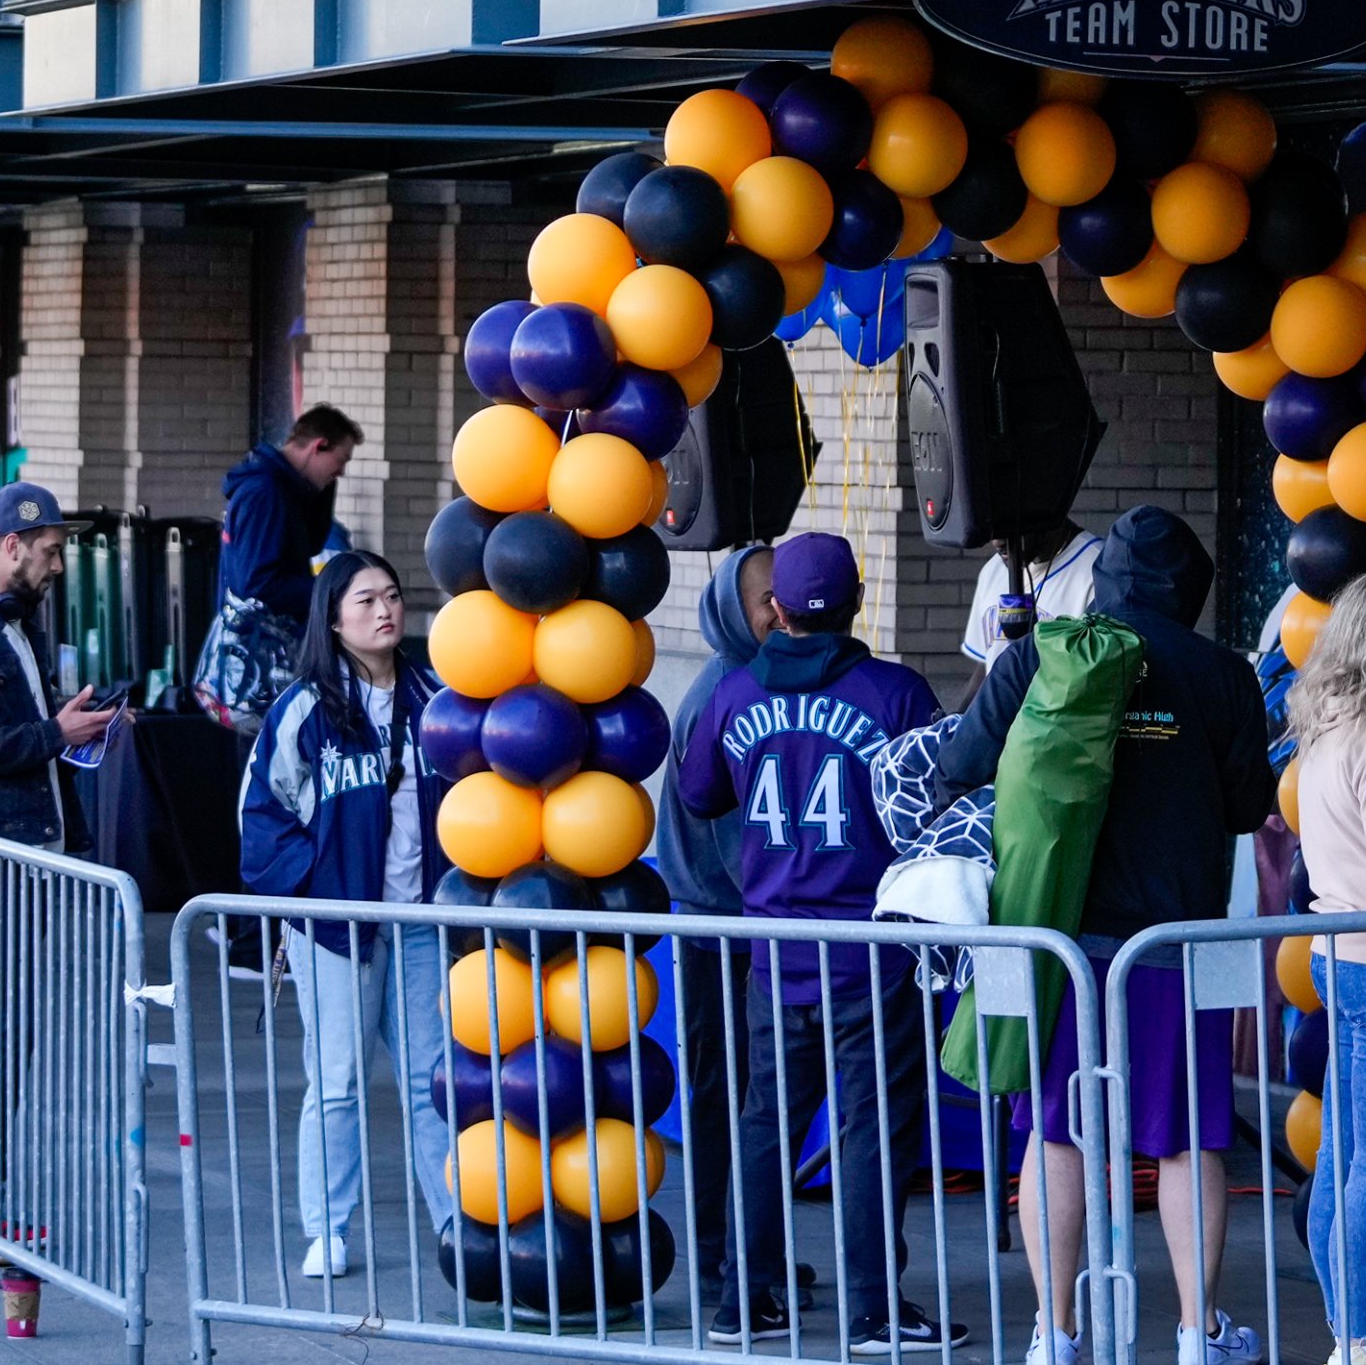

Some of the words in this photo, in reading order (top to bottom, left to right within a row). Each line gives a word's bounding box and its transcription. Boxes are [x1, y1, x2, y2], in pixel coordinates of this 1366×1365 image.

[1044, 0, 1135, 46] TEAM
[1160, 0, 1269, 52] STORE
[723, 694, 892, 766] RODRIGUEZ
[745, 754, 856, 851] 44
